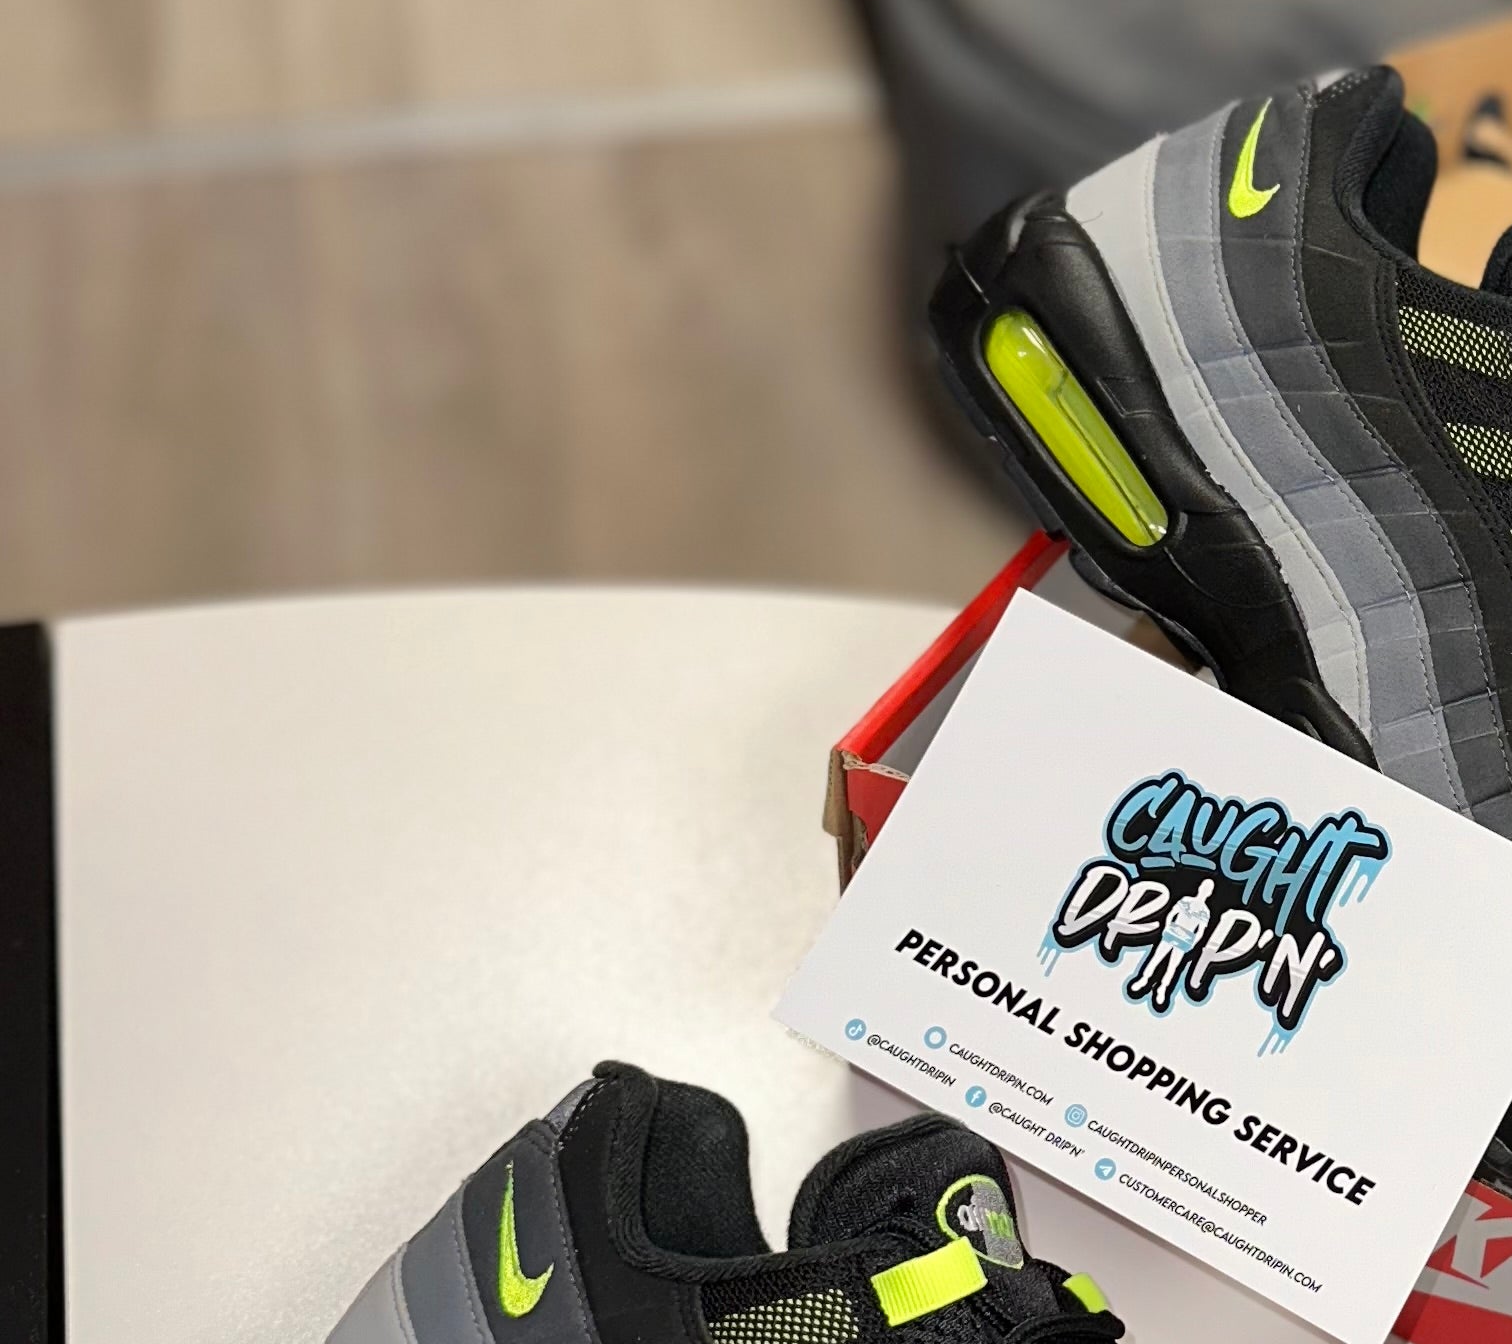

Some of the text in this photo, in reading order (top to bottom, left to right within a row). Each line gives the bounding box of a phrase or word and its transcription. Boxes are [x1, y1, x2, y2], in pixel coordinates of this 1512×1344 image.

[1111, 777, 1380, 937] CAUGHT
[867, 1034, 957, 1088] @CAUGHTDRIPIN
[894, 929, 1377, 1207] PERSONAL SHOPPING SERVICE
[949, 1043, 1054, 1106] CAUGHTDRIPIN.COM
[988, 1102, 1046, 1138] @CAUGHT
[1087, 1120, 1268, 1227] CAUGHTDRIPINPERSONALSHOPPER
[1118, 1173, 1323, 1293] CUSTOMERCARE@CAUGHTDRIPIN.COM
